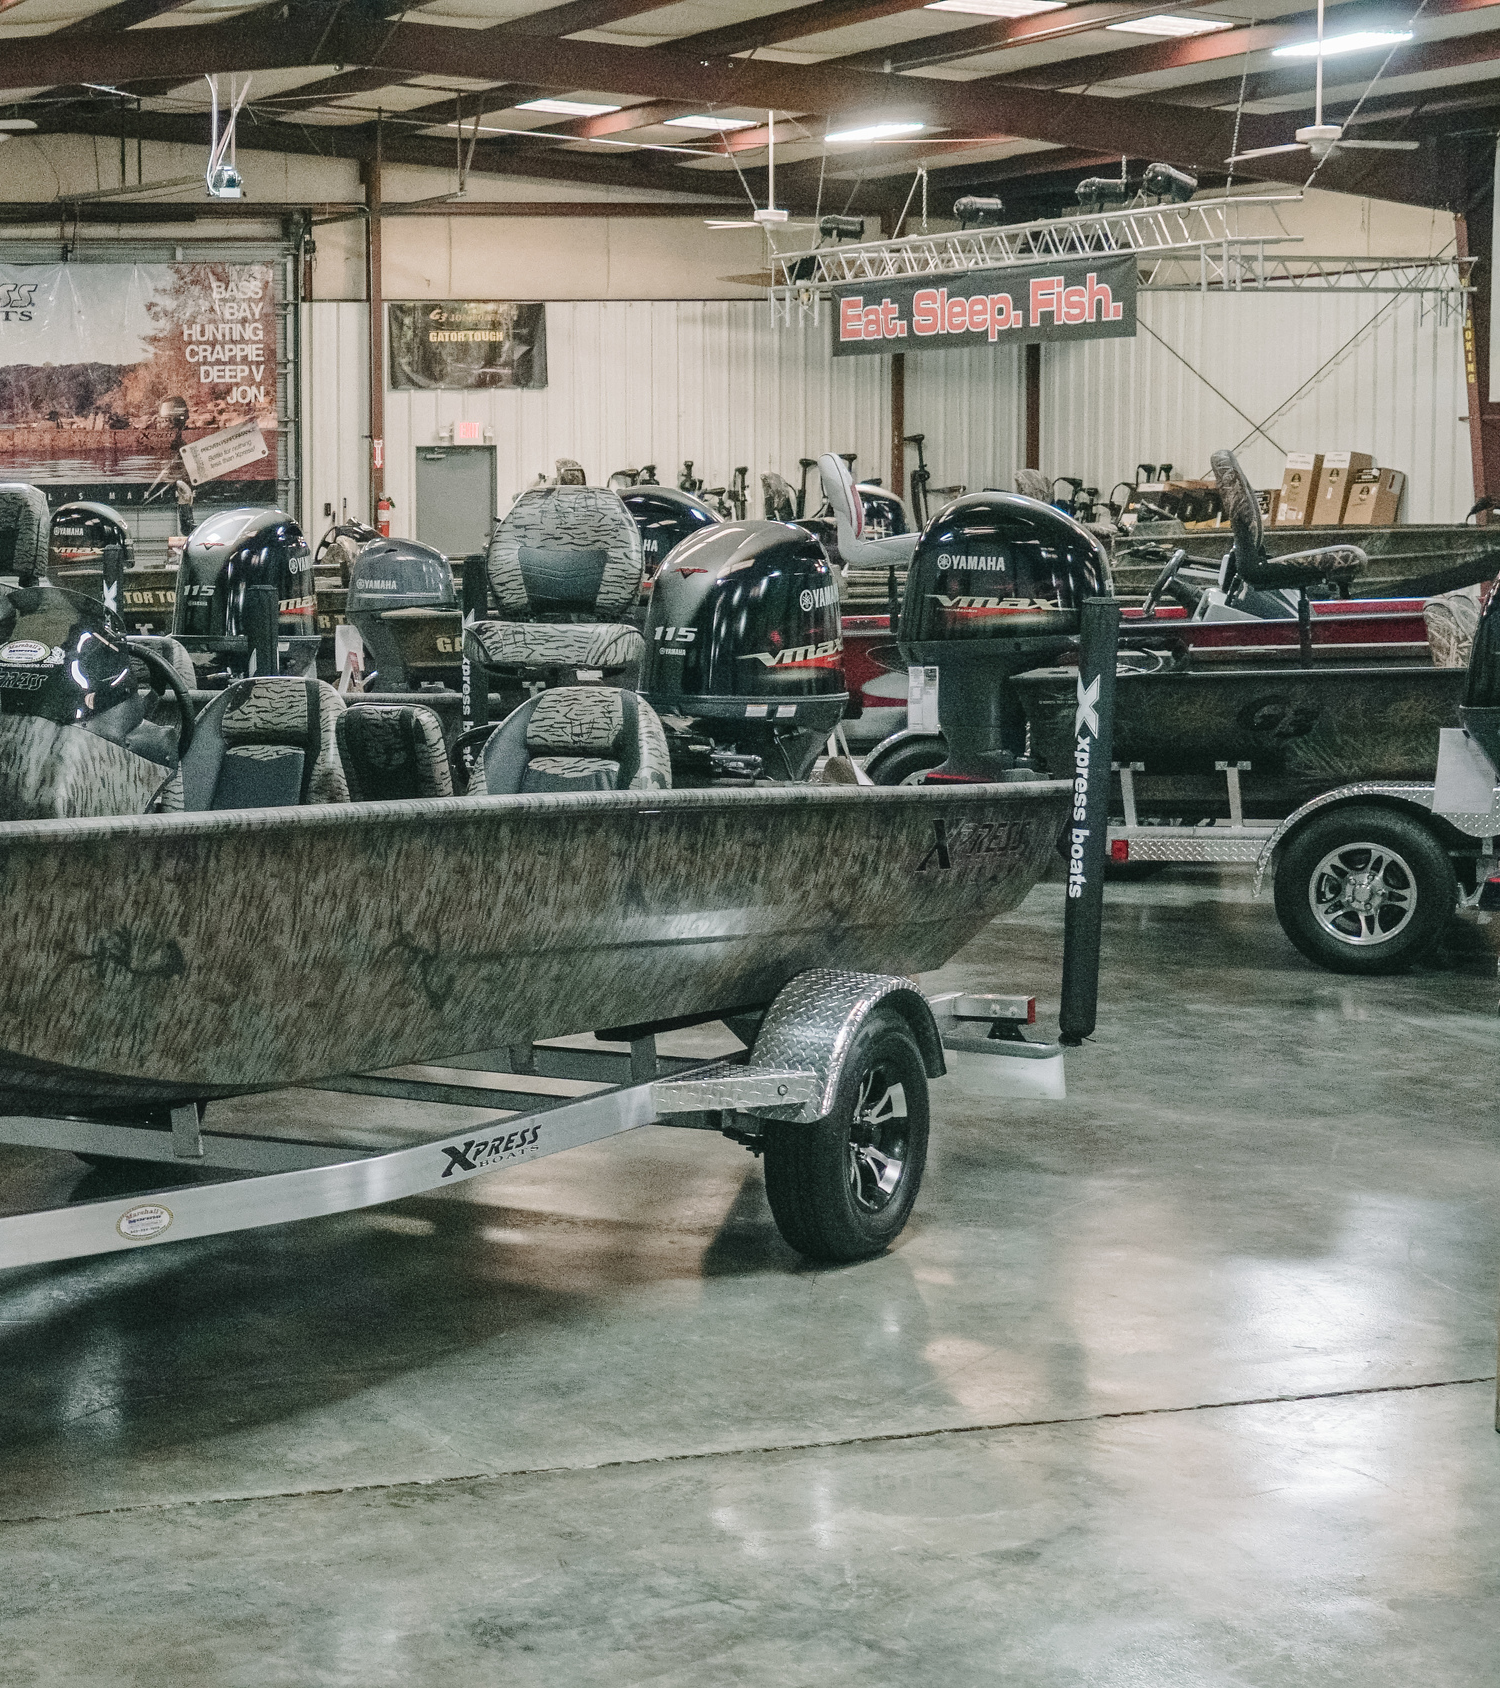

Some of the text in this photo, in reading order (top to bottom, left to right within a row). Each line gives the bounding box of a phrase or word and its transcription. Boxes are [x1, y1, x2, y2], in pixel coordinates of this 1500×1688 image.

[212, 280, 263, 299] BASS
[225, 302, 263, 320] BAY
[428, 309, 448, 322] G3
[840, 273, 1123, 342] Eat. Sleep. Fish.
[183, 322, 263, 341] HUNTING
[429, 331, 503, 342] GATOR TOUGH
[185, 344, 265, 363] CRAPPIE
[200, 365, 265, 383] DEEP V
[226, 386, 264, 404] JON
[459, 422, 480, 438] EXIT
[60, 527, 84, 536] YAMAHA
[952, 555, 1005, 571] YAMAHA
[183, 584, 216, 597] 115
[365, 579, 397, 590] YAMAHA
[124, 592, 154, 604] TOR
[812, 585, 839, 608] YAMA
[654, 627, 698, 642] 115
[665, 648, 686, 656] YAMAHA
[915, 817, 1032, 872] XPRESS
[1068, 827, 1090, 899] boats
[441, 1124, 542, 1178] XPRESS
[479, 1144, 540, 1168] BOATS
[125, 1208, 165, 1221] Marshall's
